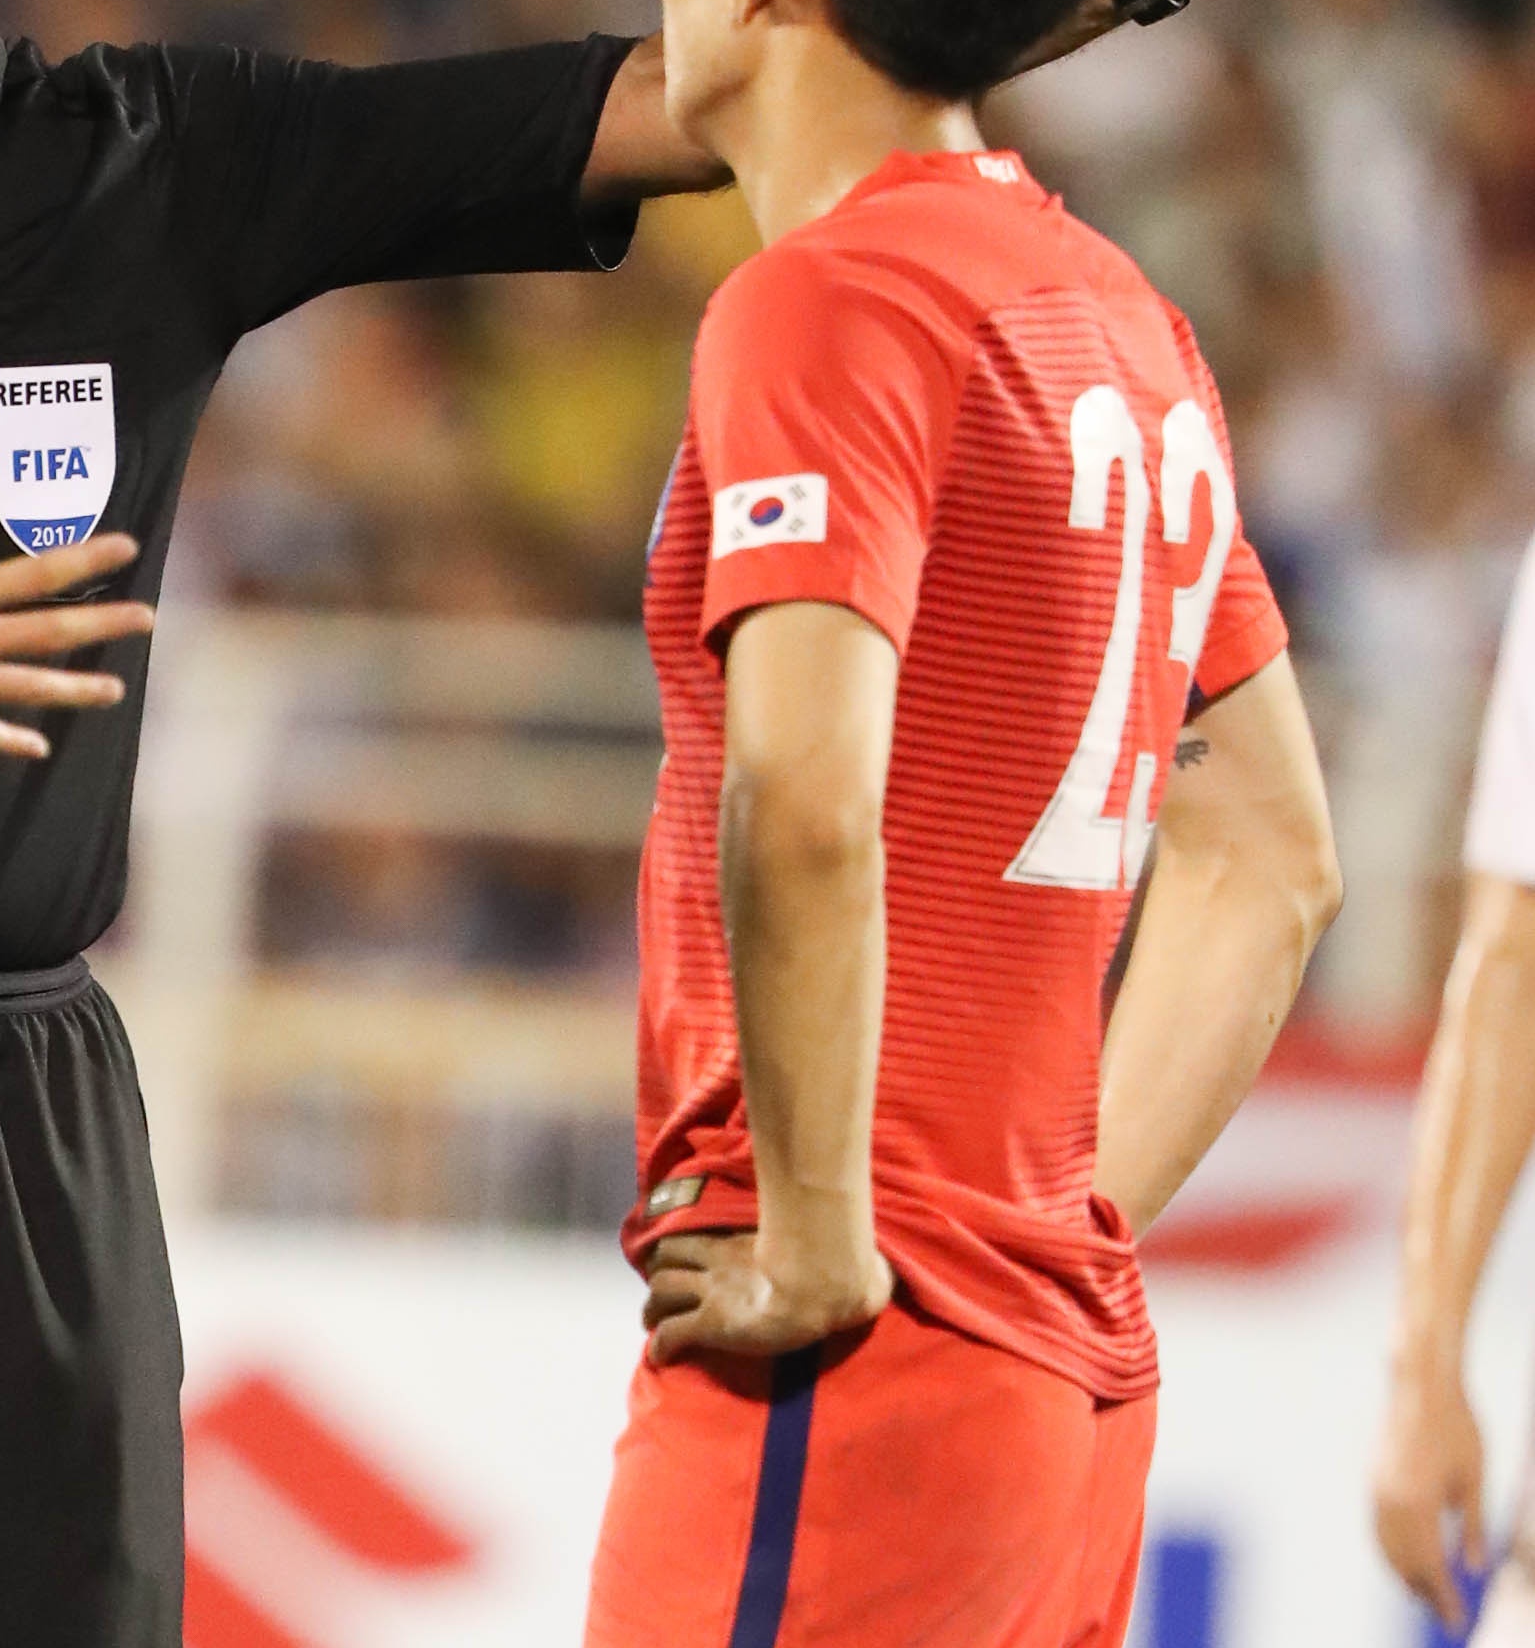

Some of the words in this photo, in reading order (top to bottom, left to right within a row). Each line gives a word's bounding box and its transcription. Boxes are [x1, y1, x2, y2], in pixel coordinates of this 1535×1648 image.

[11, 445, 90, 482] FIFA
[30, 524, 77, 549] 2017
[1003, 384, 1237, 892] 23
